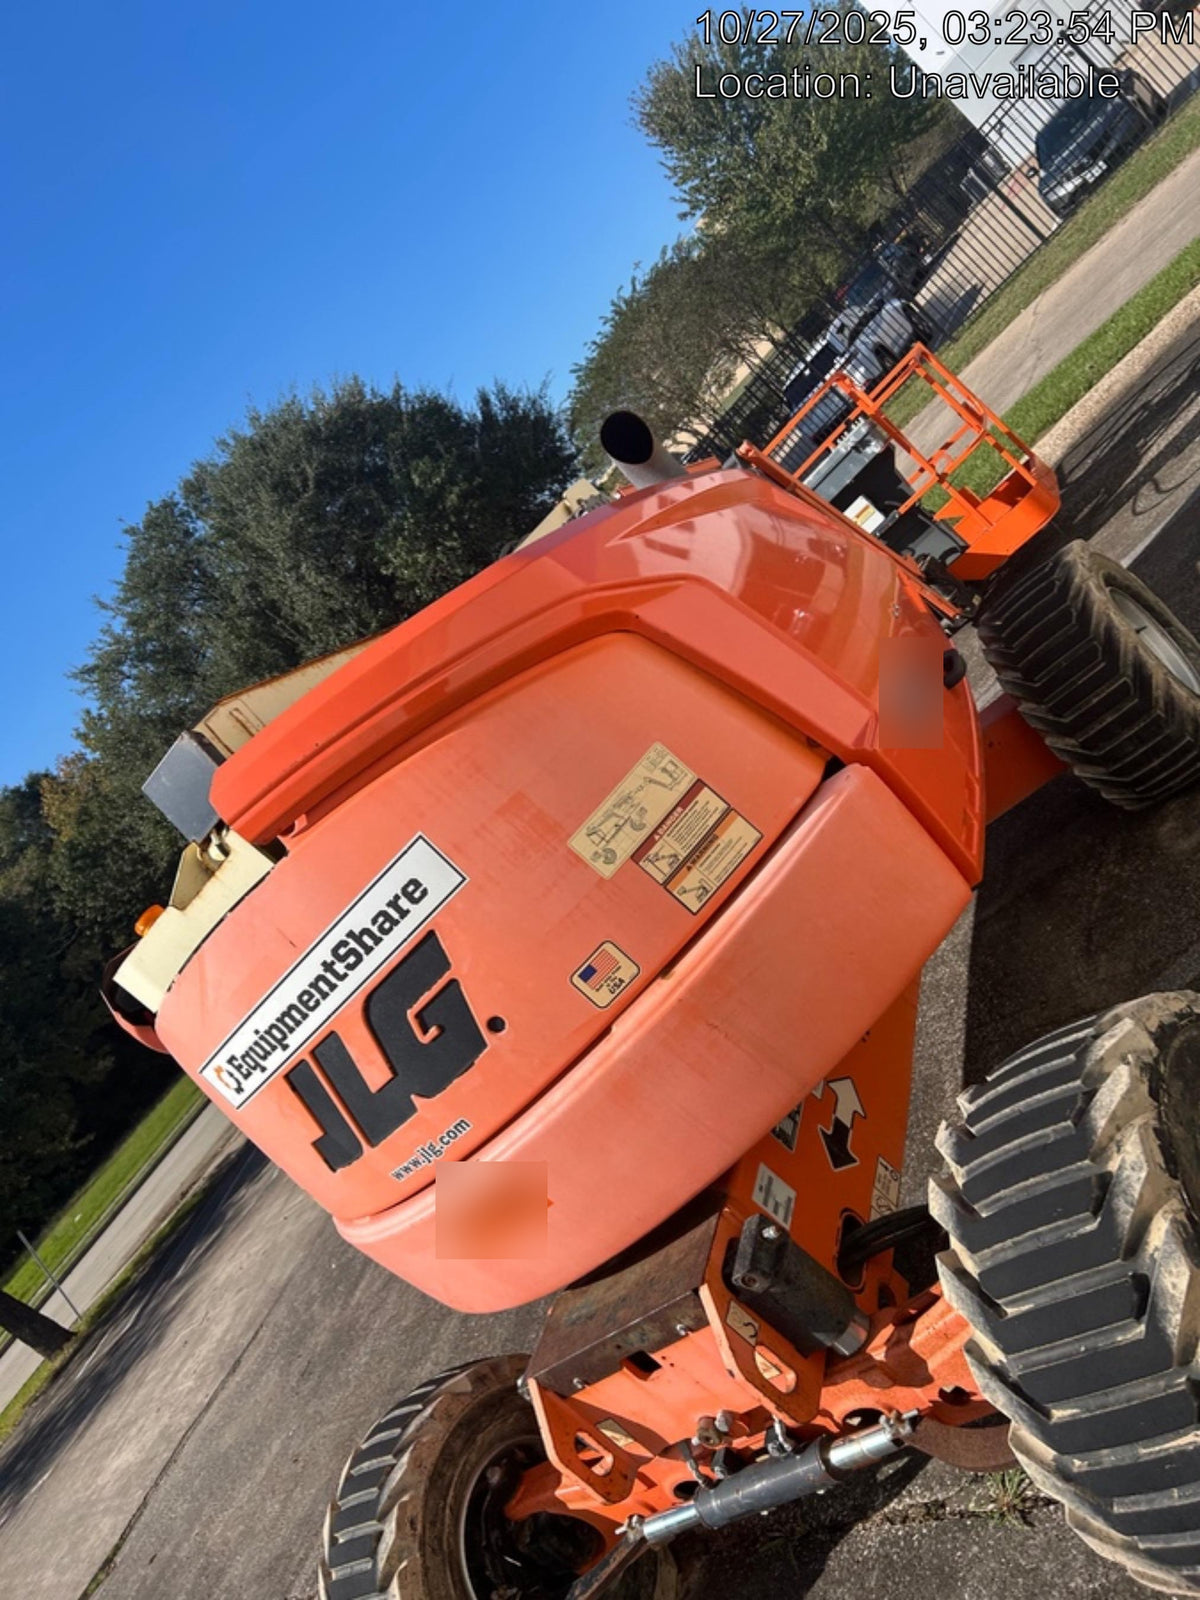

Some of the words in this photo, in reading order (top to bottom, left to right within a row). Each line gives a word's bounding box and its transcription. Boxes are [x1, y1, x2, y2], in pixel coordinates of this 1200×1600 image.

[226, 877, 430, 1081] EquipmentShare
[283, 929, 489, 1173] JLG
[391, 1118, 471, 1182] www.jlg.com
